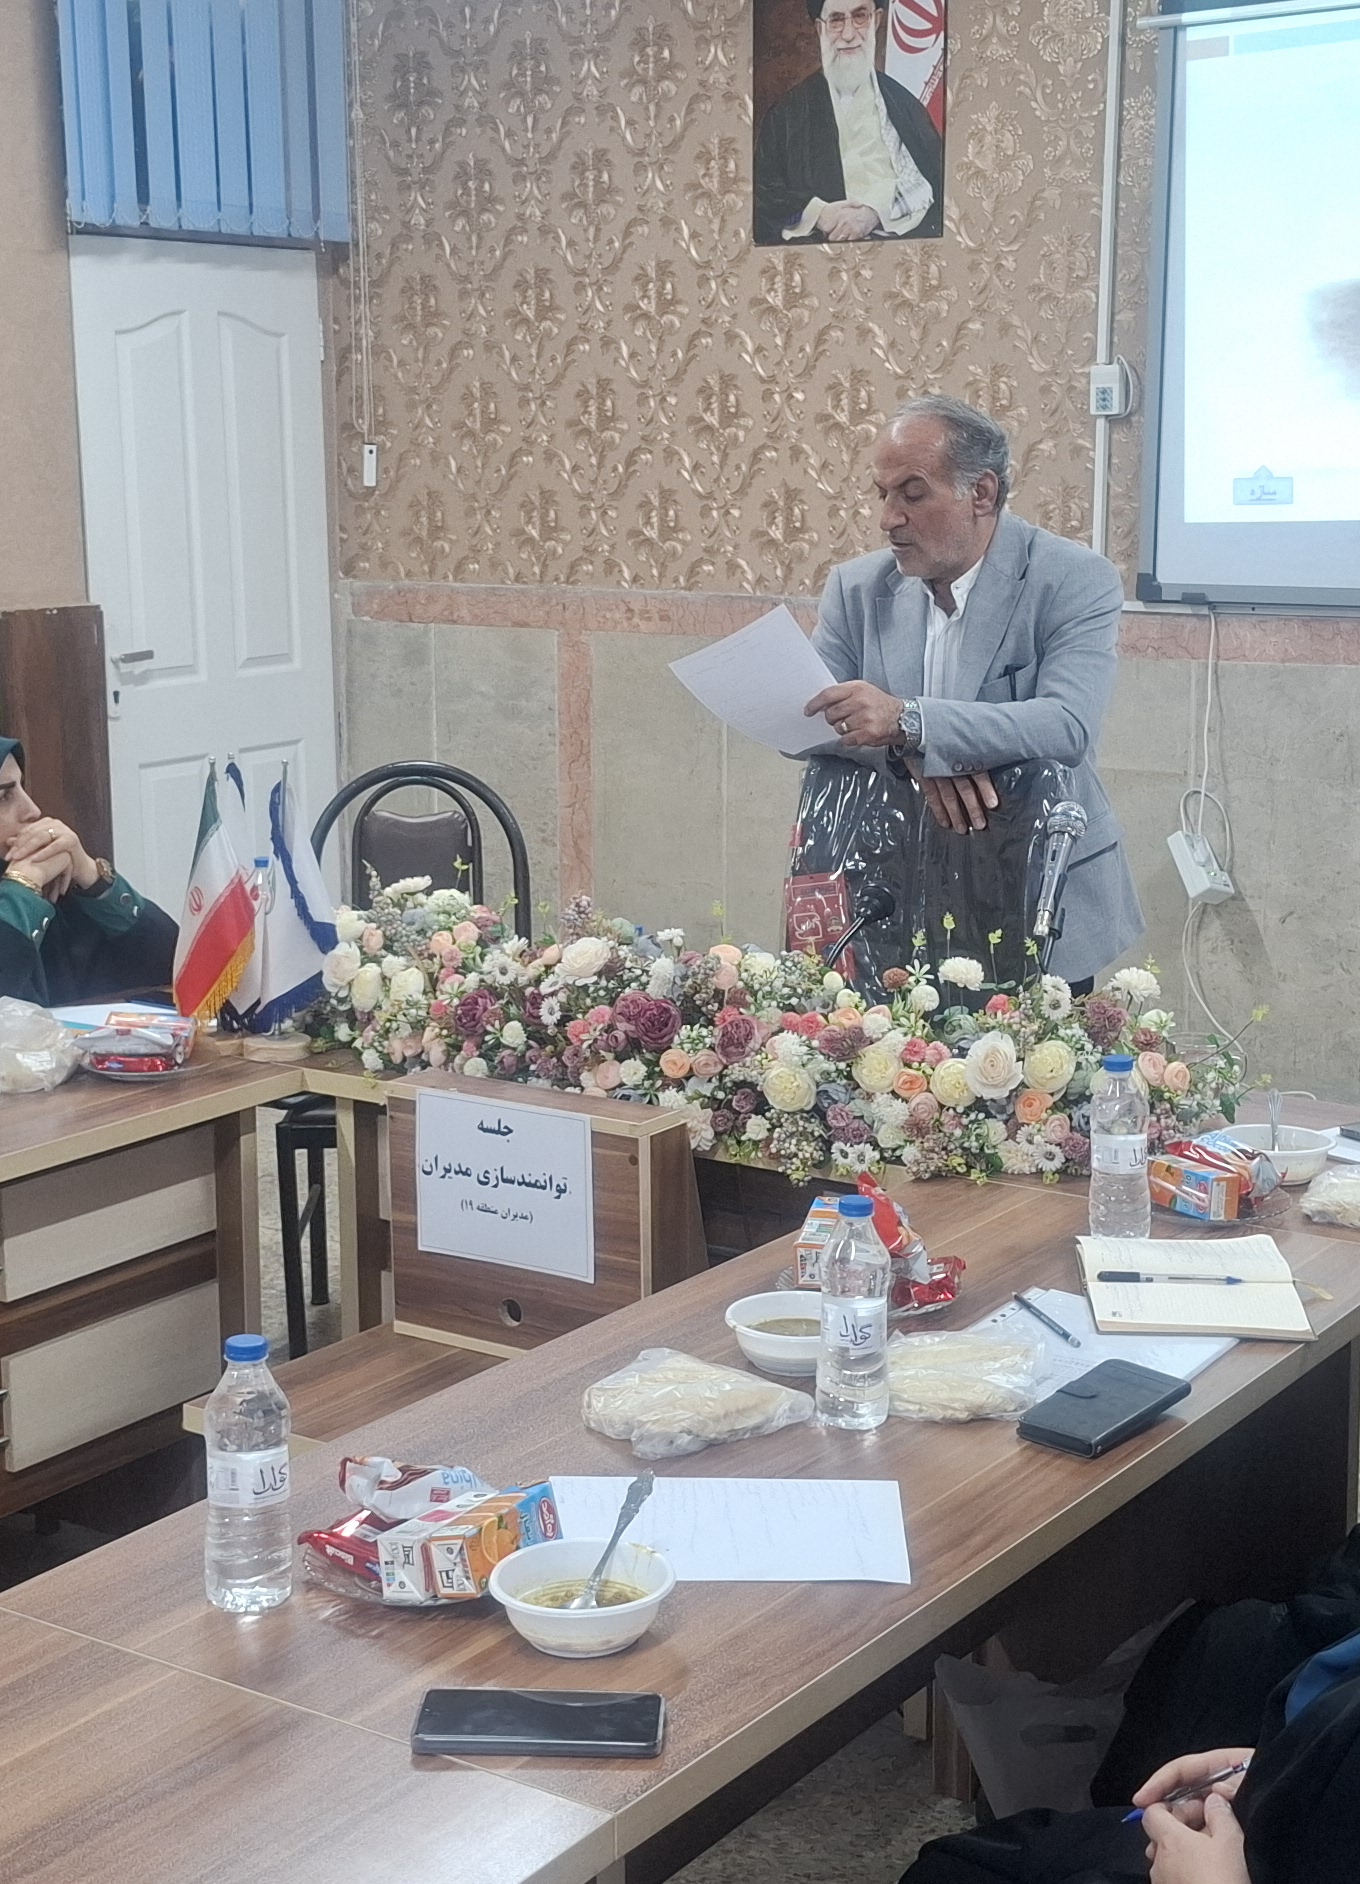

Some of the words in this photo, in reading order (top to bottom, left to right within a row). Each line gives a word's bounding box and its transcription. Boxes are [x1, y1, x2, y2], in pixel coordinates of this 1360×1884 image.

[477, 1118, 514, 1143] جلسه
[421, 1154, 472, 1180] مدیران
[476, 1165, 568, 1200] توانمندسازی
[476, 1202, 499, 1215] منطقه
[500, 1207, 534, 1224] (مدیران
